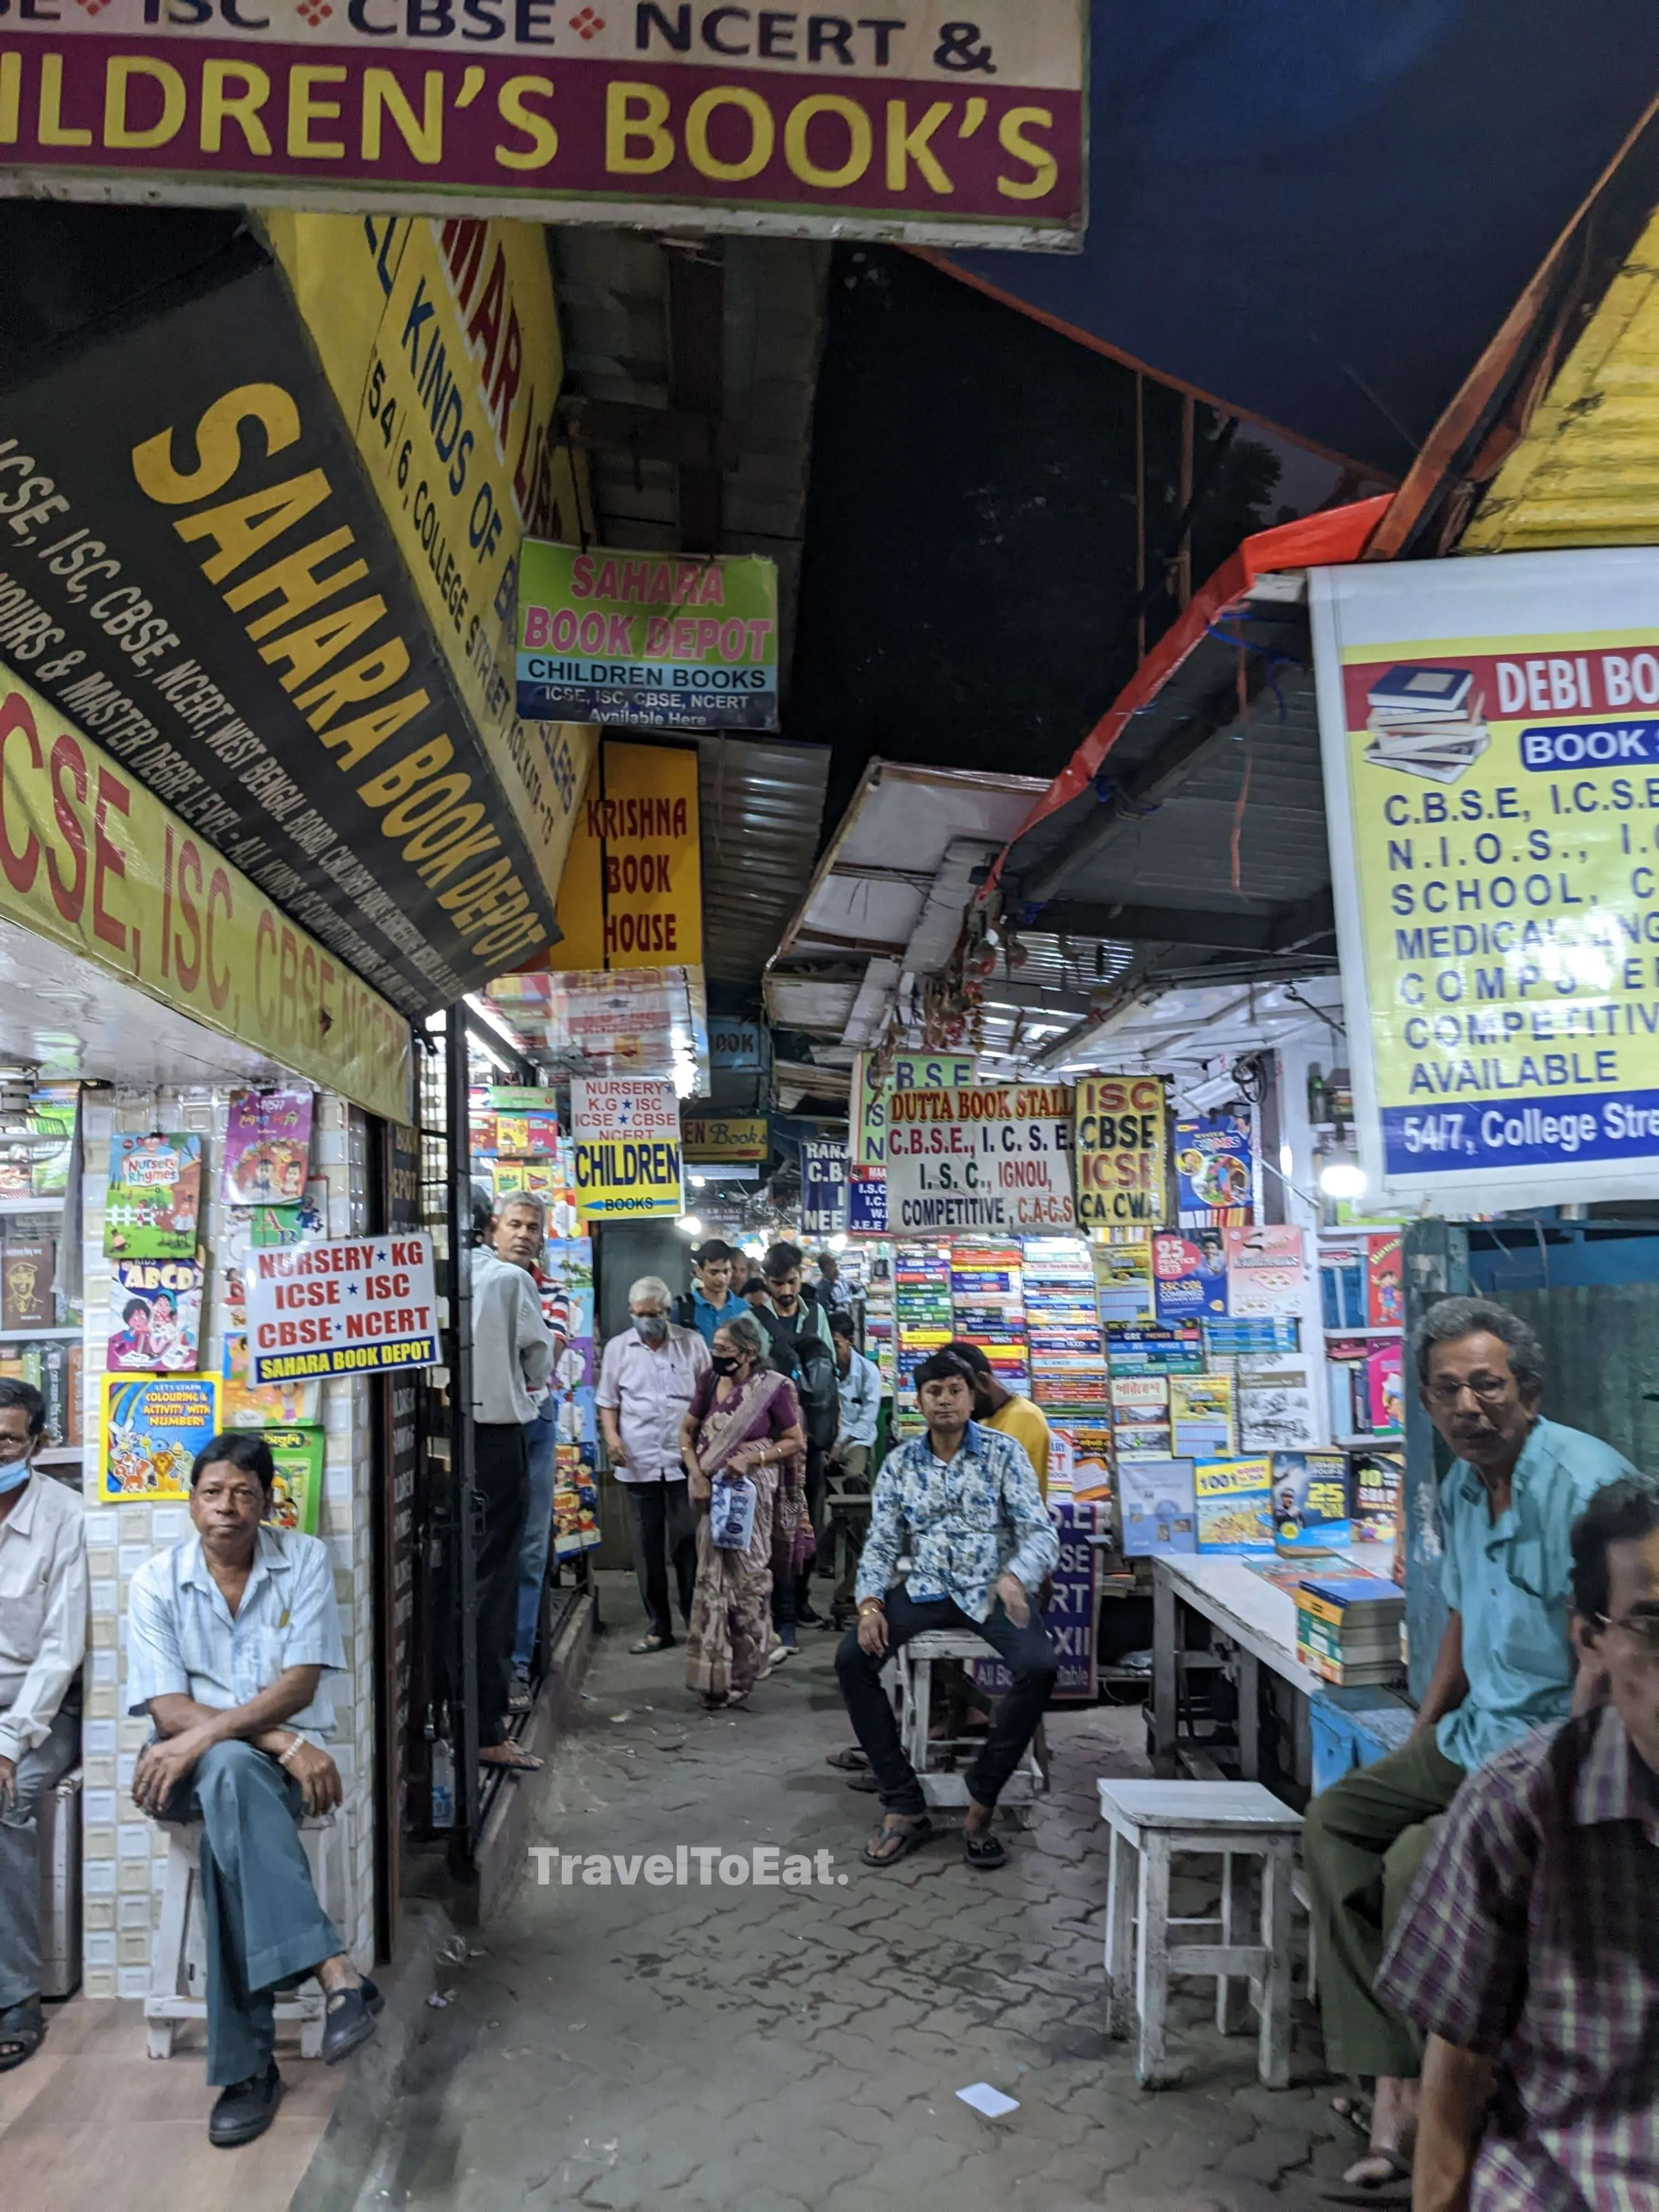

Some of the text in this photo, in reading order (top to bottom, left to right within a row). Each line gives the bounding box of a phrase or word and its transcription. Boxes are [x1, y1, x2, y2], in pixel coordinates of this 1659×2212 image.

[348, 0, 554, 44] CBSE
[635, 1, 906, 66] NCERT
[933, 22, 997, 75] &
[605, 80, 1058, 200] BOOK'S
[401, 274, 473, 496] KINDS
[469, 482, 503, 564] OF
[368, 359, 411, 510] 54/6,
[413, 481, 470, 633] COLLEGE
[571, 554, 725, 607] SAHARA
[524, 606, 773, 663] BOOK DEPOT
[35, 650, 87, 682] &
[37, 528, 122, 604] ISC,
[90, 586, 181, 678] CBSE,
[153, 659, 236, 739] NCERT,
[205, 714, 267, 770] WEST
[238, 757, 307, 822] BENGAL
[132, 382, 431, 772] SAHARA
[356, 733, 502, 890] BOOK
[436, 856, 549, 967] DEPOT
[528, 659, 766, 689] CHILDREN BOOKS
[1496, 657, 1592, 713] DEBI
[57, 671, 160, 756] MASTER
[545, 687, 749, 710] ICSE, ISC, CBSE, NCERT
[590, 708, 706, 727] Available Here
[1524, 729, 1650, 764] BOOK
[128, 742, 205, 808] DEGRE
[586, 797, 687, 839] KRISHNA
[1384, 786, 1531, 827] C.B.S.E,
[1388, 828, 1588, 871] N.I.O.S.,
[607, 854, 672, 894] BOOK
[1391, 872, 1599, 915] SCHOOL,
[161, 822, 240, 1030] ISC,
[604, 913, 677, 953] HOUSE
[586, 1082, 662, 1095] NURSERY
[1409, 1049, 1620, 1094] AVAILABLE
[589, 1098, 662, 1111] K.G ISC
[891, 1087, 1075, 1123] DUTTA BOOK STALL
[1086, 1082, 1160, 1114] ISC
[575, 1113, 676, 1127] ICSE CBSE
[682, 1121, 769, 1146] EN Books
[1080, 1115, 1159, 1151] CBSE
[1481, 1108, 1598, 1153] College
[128, 1159, 176, 1172] Nursery
[128, 1170, 177, 1183] Rhymes
[575, 1144, 680, 1188] CHILDREN
[998, 1160, 1052, 1192] IGNOU,
[1081, 1153, 1159, 1190] ICSE
[605, 1196, 654, 1211] BOOKS
[258, 1240, 424, 1279] NURSERY KG
[1156, 1240, 1185, 1258] 25
[125, 1264, 194, 1290] ABCD
[275, 1273, 410, 1310] ICSE ISC
[257, 1306, 431, 1349] CBSE NCERT
[1123, 1331, 1142, 1341] GRE
[259, 1340, 431, 1380] SAHARA BOOK DEPOT
[143, 1404, 211, 1414] ACTIVITY WITH
[145, 1392, 198, 1402] COLOURING
[1308, 1483, 1345, 1503] 25
